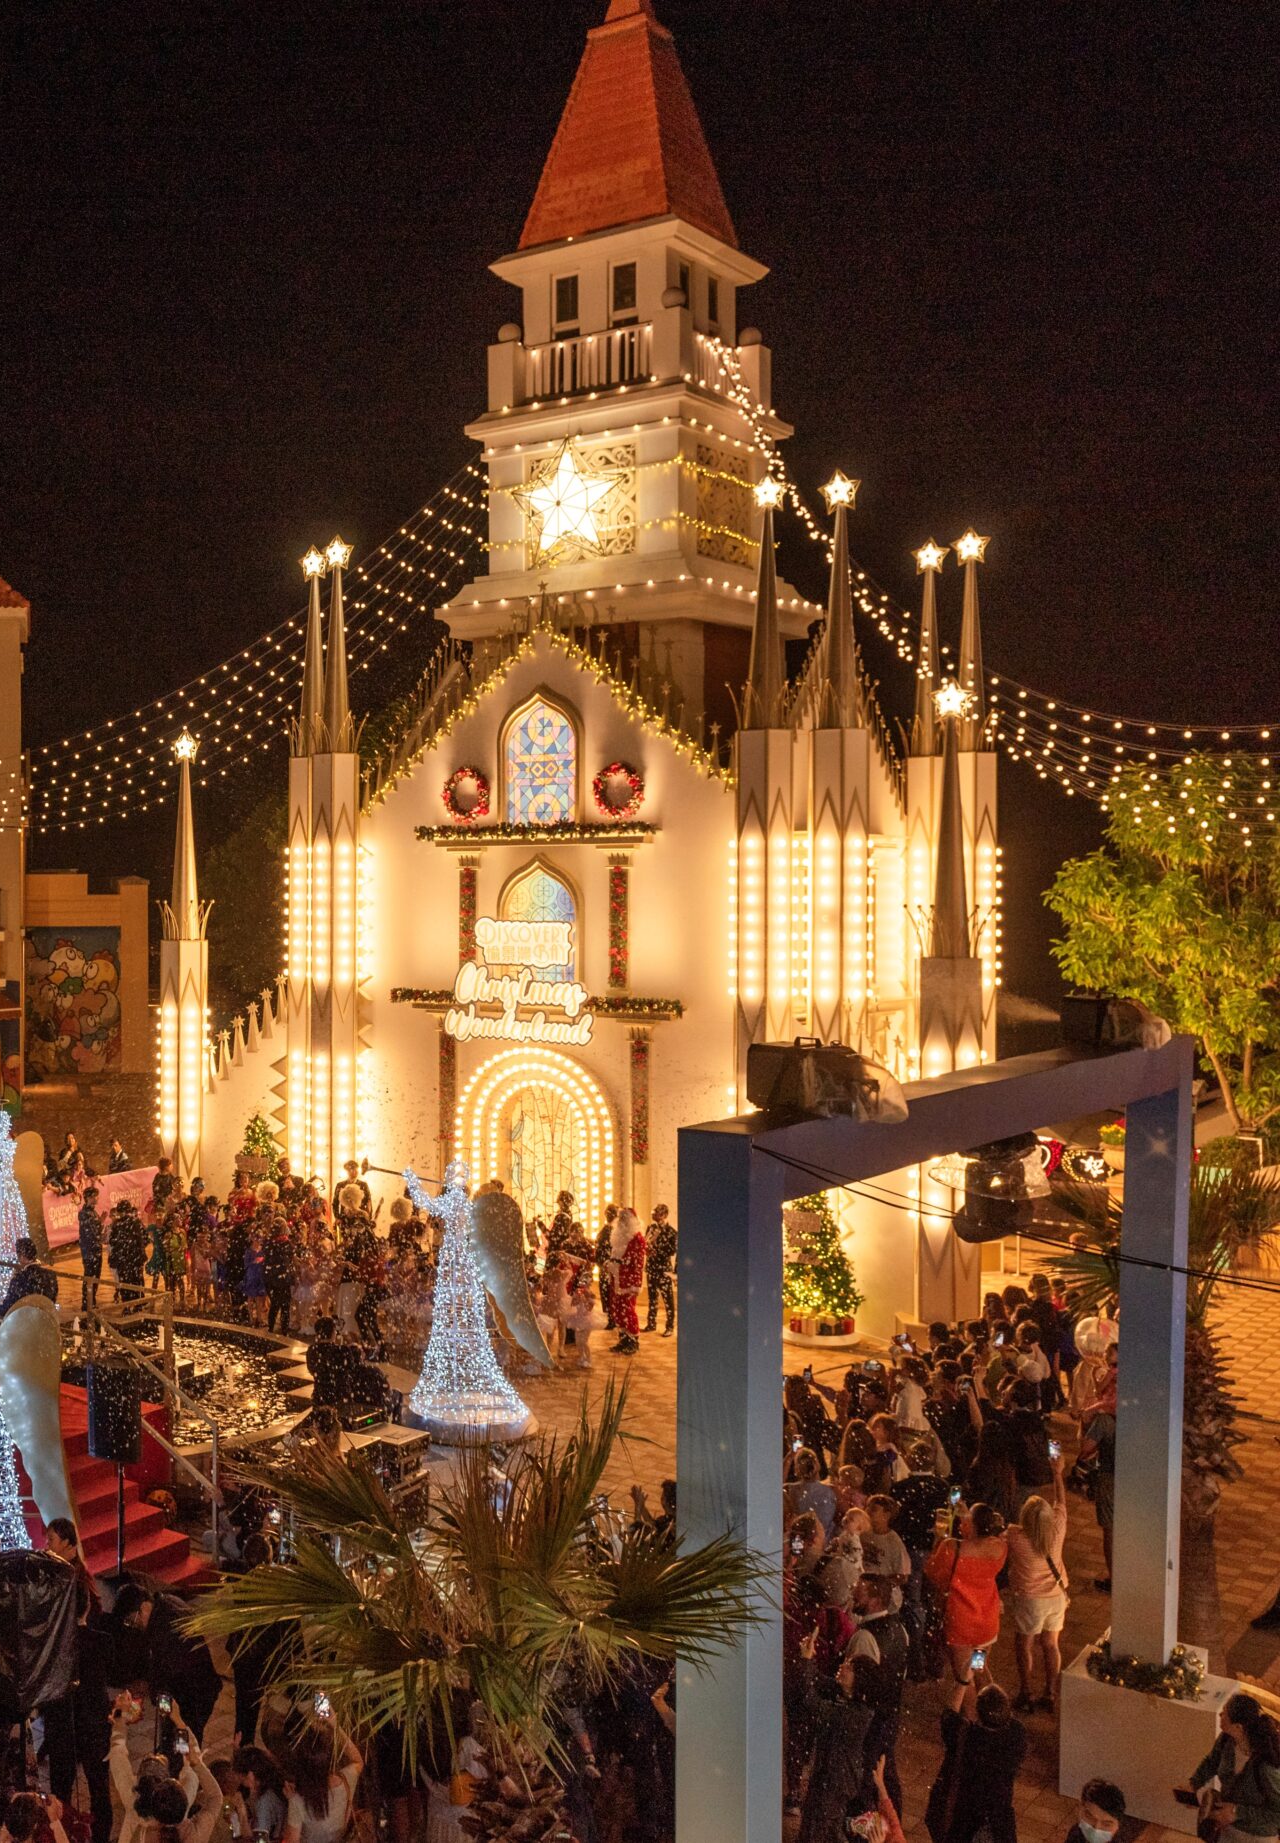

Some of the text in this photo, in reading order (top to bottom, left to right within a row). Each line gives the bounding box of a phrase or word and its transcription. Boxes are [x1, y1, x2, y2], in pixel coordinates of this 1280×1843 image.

[478, 922, 567, 944] DISCOVERY
[533, 943, 566, 964] BAY
[456, 963, 587, 1016] Christmas
[446, 1006, 593, 1046] Wonderland
